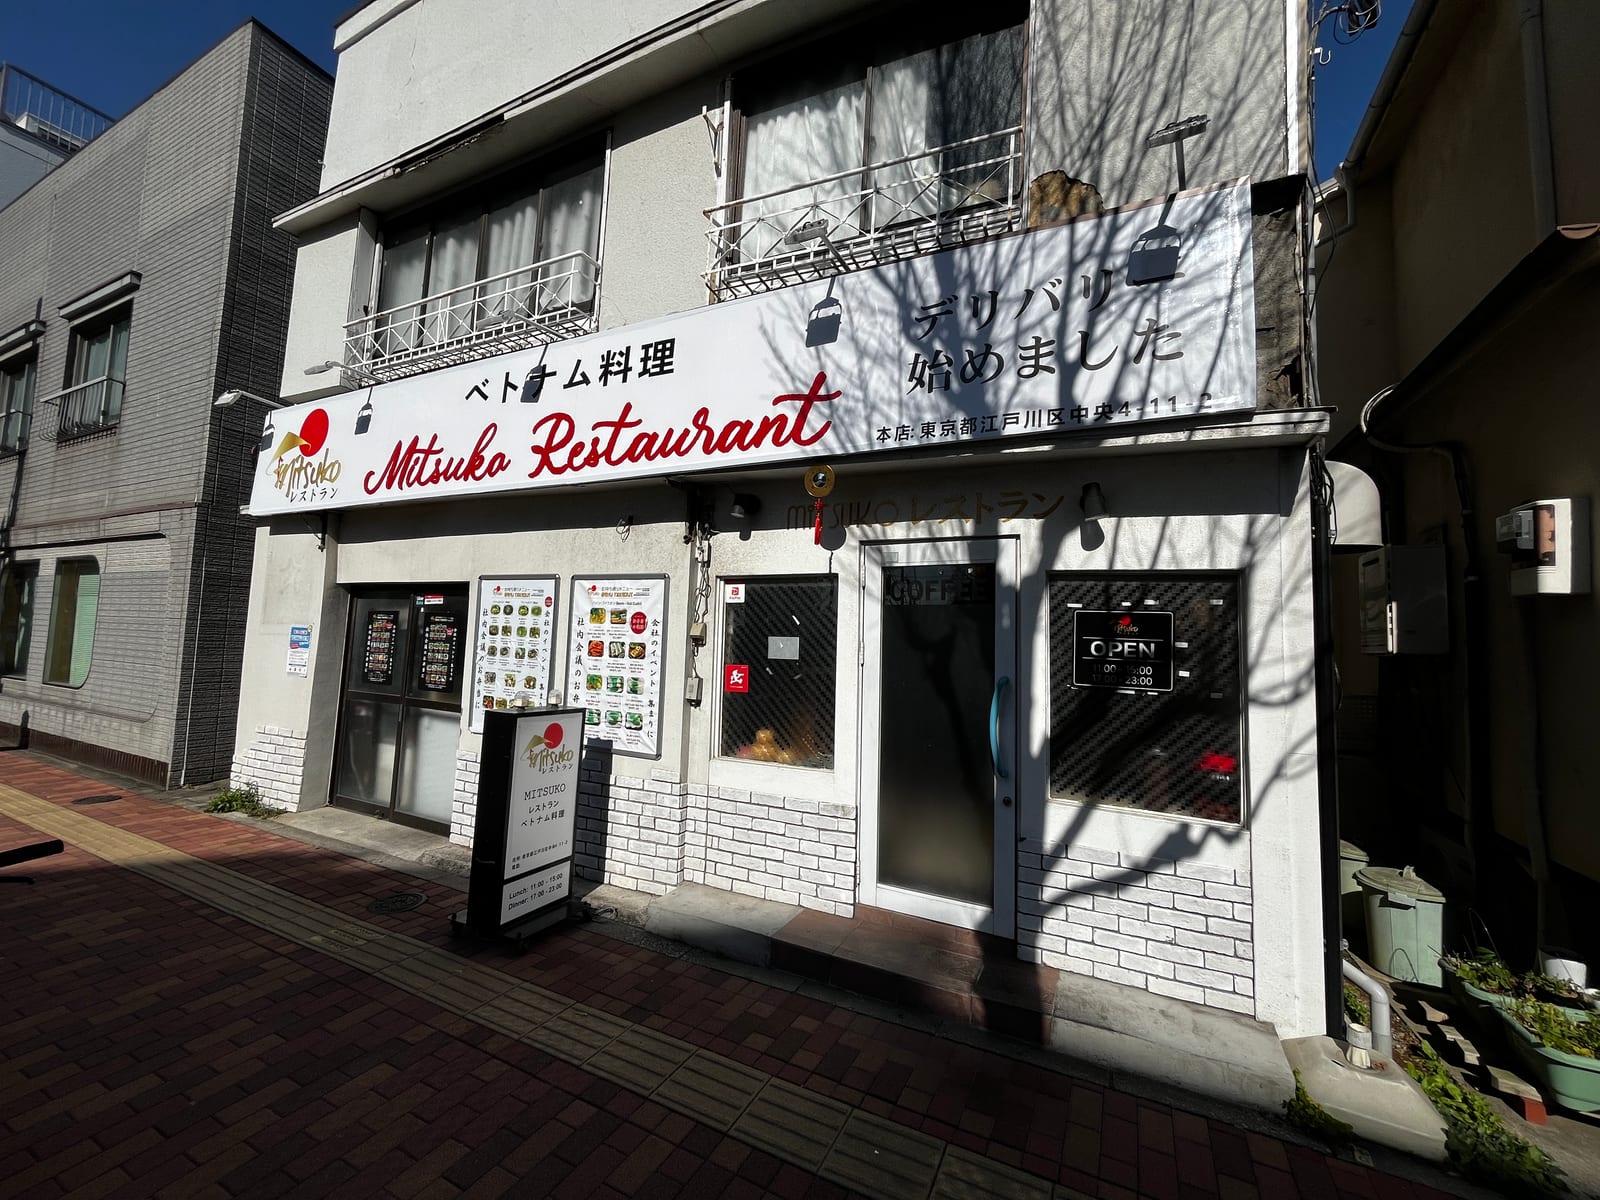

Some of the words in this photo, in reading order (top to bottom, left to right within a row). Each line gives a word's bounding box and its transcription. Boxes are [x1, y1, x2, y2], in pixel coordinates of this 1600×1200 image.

[906, 317, 1185, 395] 始めました
[465, 338, 676, 404] ベトナム料理
[528, 371, 843, 479] Restaurant
[290, 487, 339, 502] レストラン
[911, 491, 1065, 525] レストラン
[1090, 640, 1155, 658] OPEN
[1124, 675, 1153, 686] 23:00
[542, 763, 573, 775] レストラン
[524, 783, 566, 801] MITSUKO
[528, 800, 559, 814] レストラン
[521, 809, 565, 828] ベトナム料理
[508, 897, 529, 911] Dinner:
